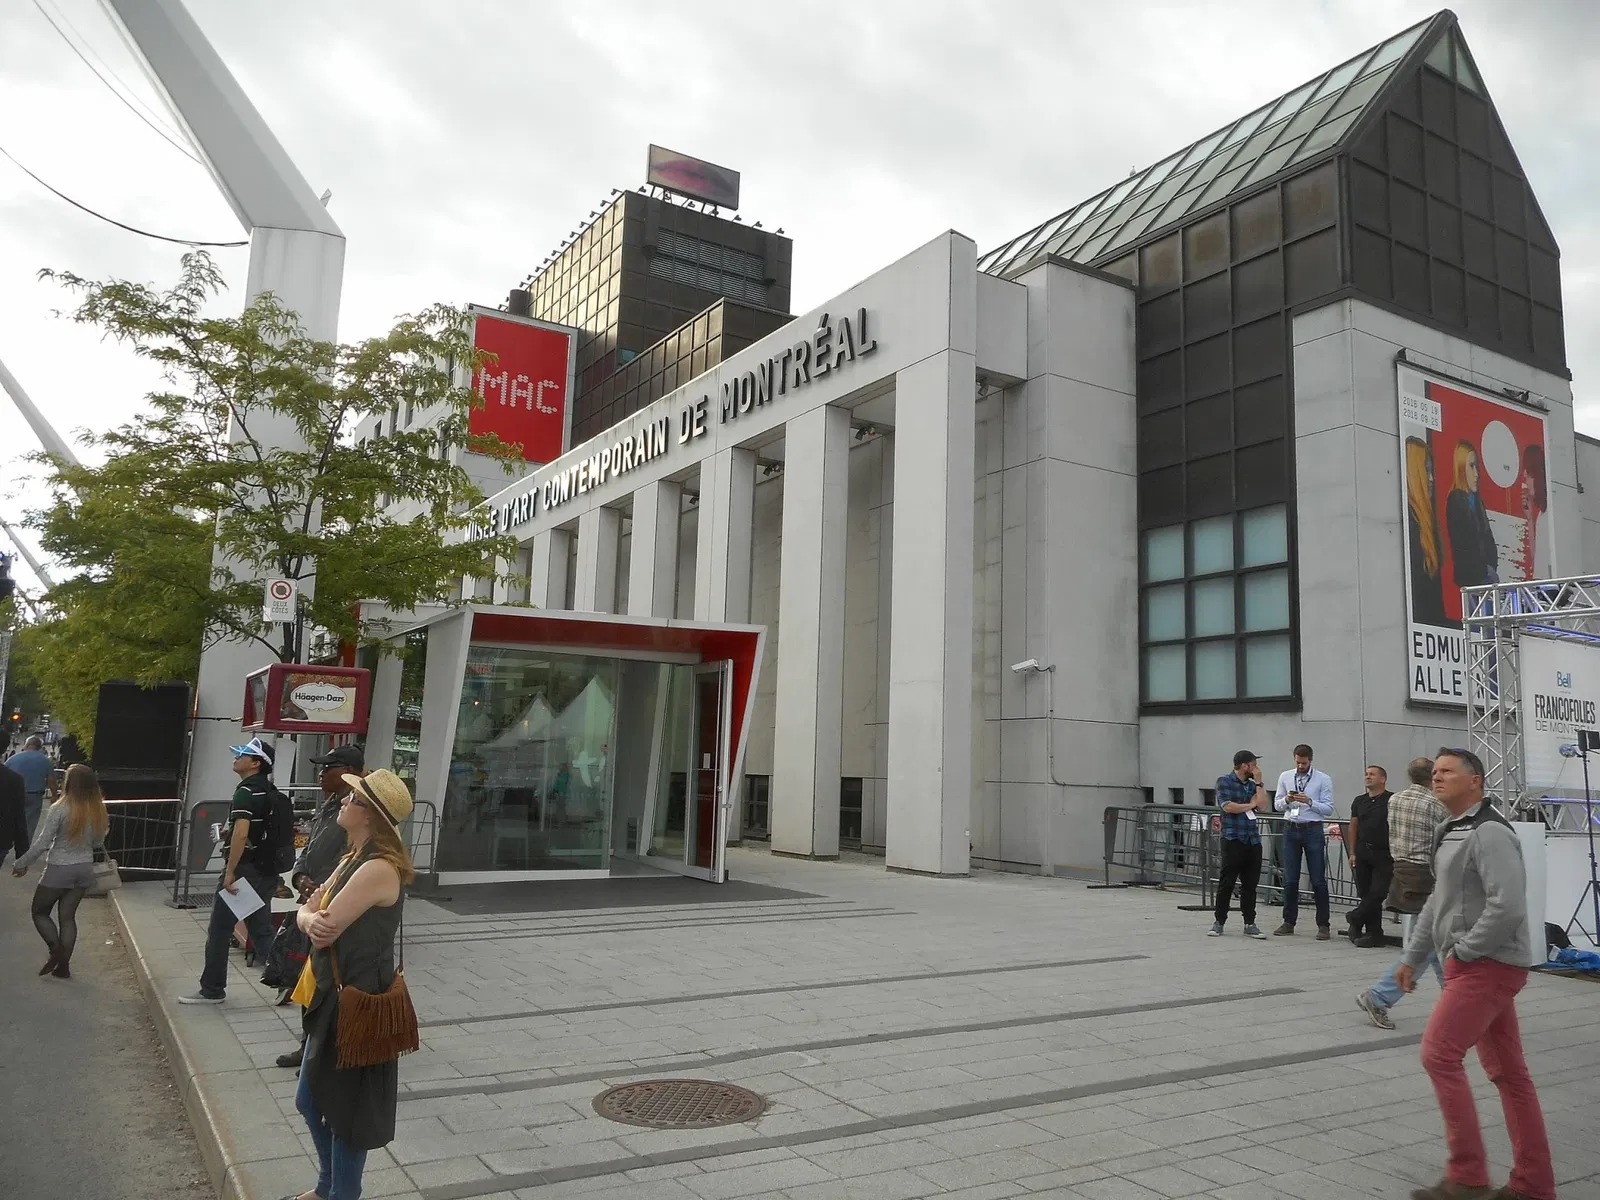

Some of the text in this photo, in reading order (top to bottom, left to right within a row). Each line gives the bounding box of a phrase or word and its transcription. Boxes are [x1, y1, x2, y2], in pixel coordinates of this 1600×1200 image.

[479, 367, 560, 414] MAC
[501, 487, 540, 532] D'ART
[543, 416, 670, 511] CONTEMPORAIN
[678, 395, 709, 445] DE
[720, 307, 877, 424] MONTRÉAL
[1413, 631, 1484, 665] EDMU
[1415, 665, 1485, 699] ALLEN
[1556, 671, 1572, 688] Bell
[295, 692, 344, 703] Häagen-Dazs
[1534, 693, 1596, 724] FRANCOFOLIES
[1535, 720, 1548, 732] DE
